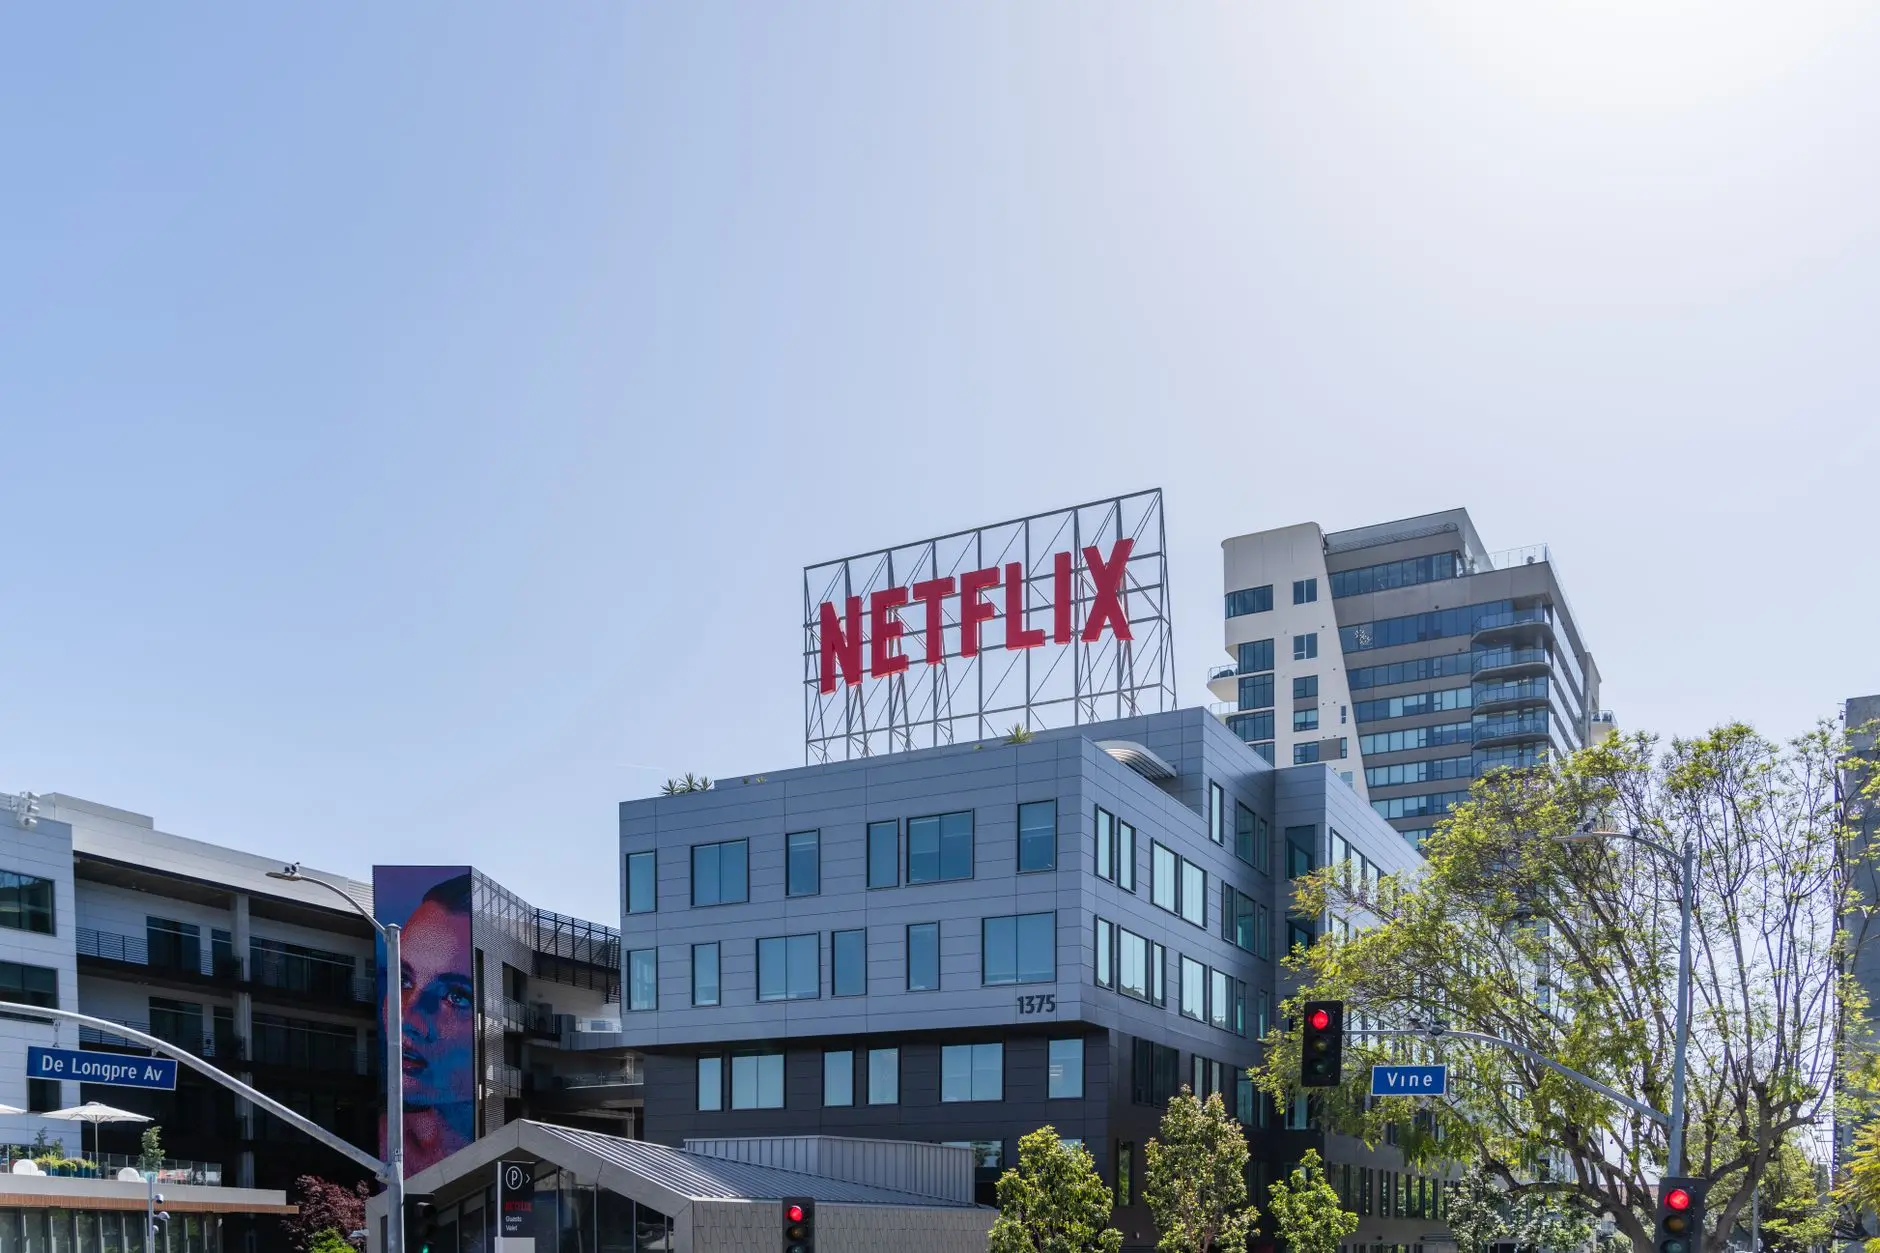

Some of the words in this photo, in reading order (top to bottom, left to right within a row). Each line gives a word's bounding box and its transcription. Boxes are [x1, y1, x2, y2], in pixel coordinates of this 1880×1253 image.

[820, 538, 1134, 695] NETFLIX
[1017, 994, 1056, 1014] 1375
[42, 1055, 64, 1073] De
[71, 1058, 137, 1081] Longpre
[143, 1066, 163, 1081] Av
[1387, 1072, 1433, 1087] Vine
